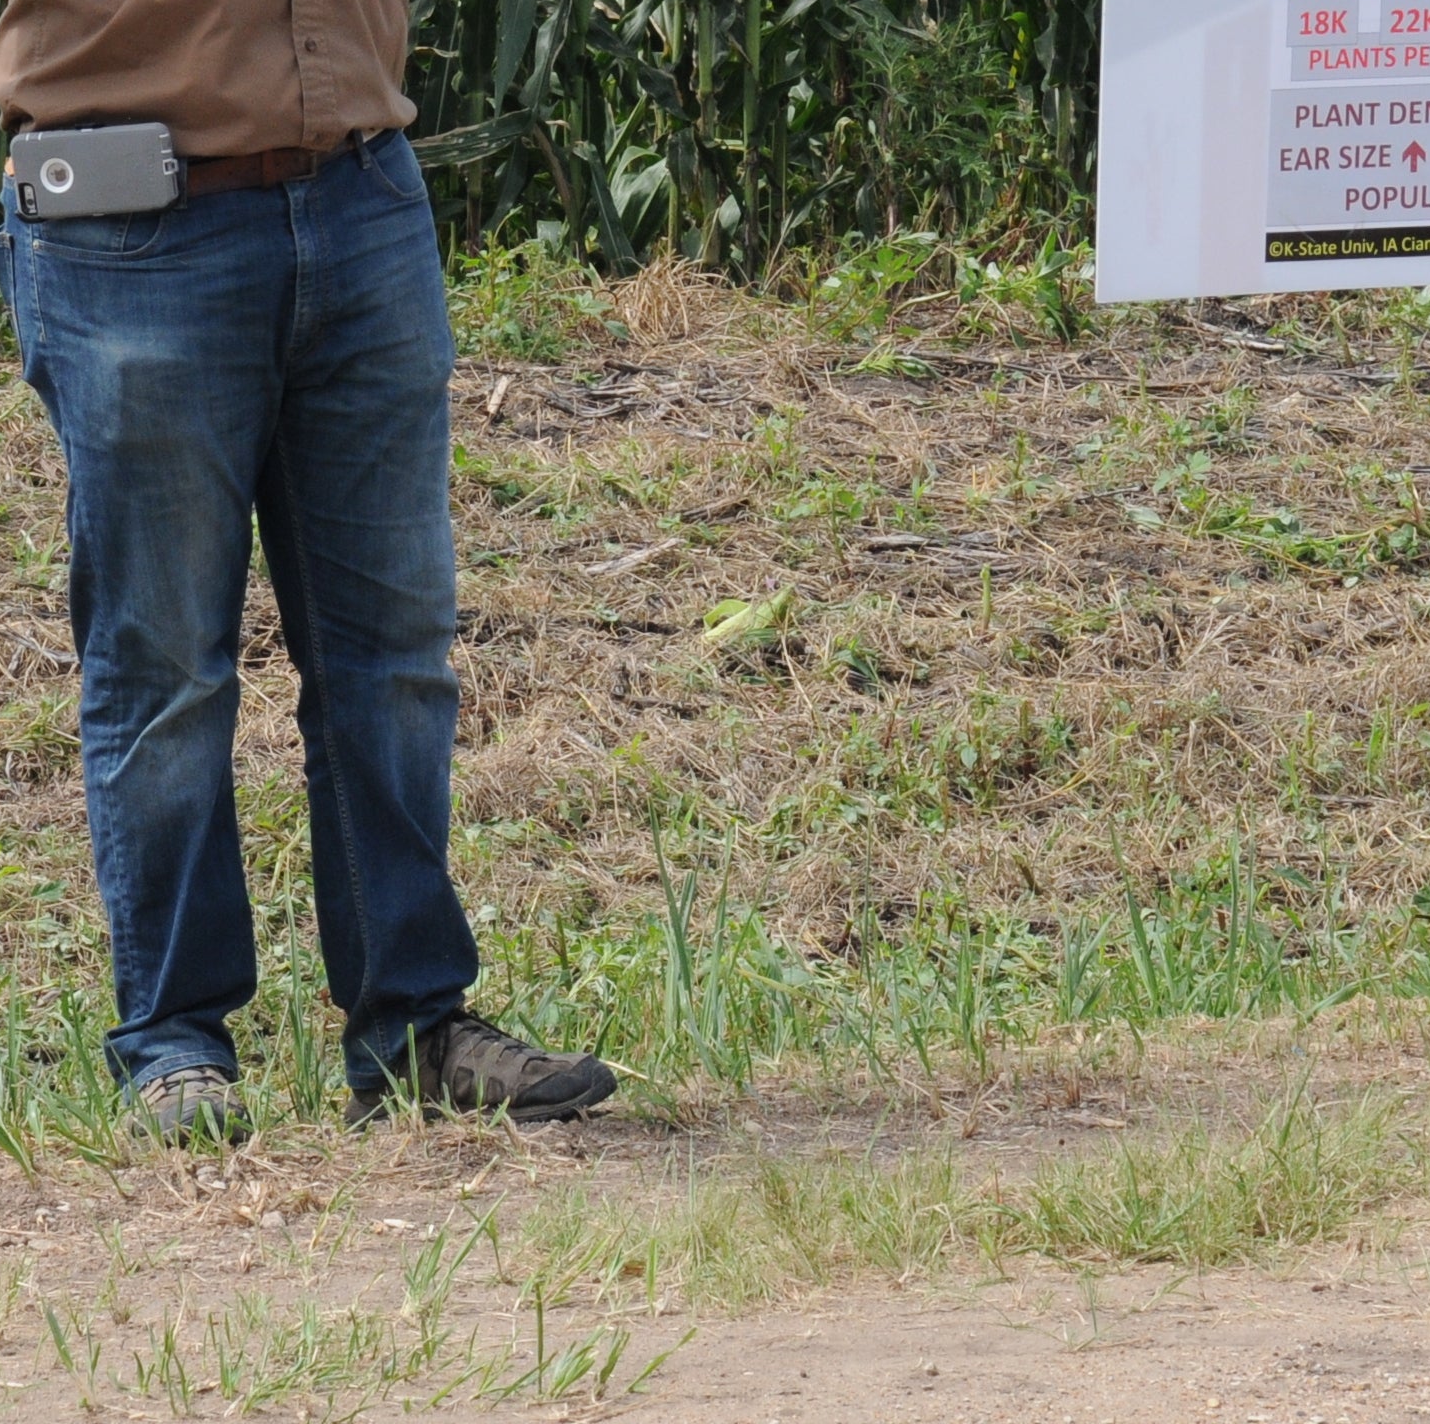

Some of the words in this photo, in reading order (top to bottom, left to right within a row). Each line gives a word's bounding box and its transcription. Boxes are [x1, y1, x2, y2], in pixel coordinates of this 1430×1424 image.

[1299, 10, 1347, 35] 18K
[1308, 47, 1396, 70] PLANTS
[1295, 102, 1380, 128] PLANT
[1279, 147, 1330, 171] EAR
[1338, 144, 1392, 168] SIZE
[1341, 237, 1378, 257] Univ,
[1383, 238, 1398, 252] IA
